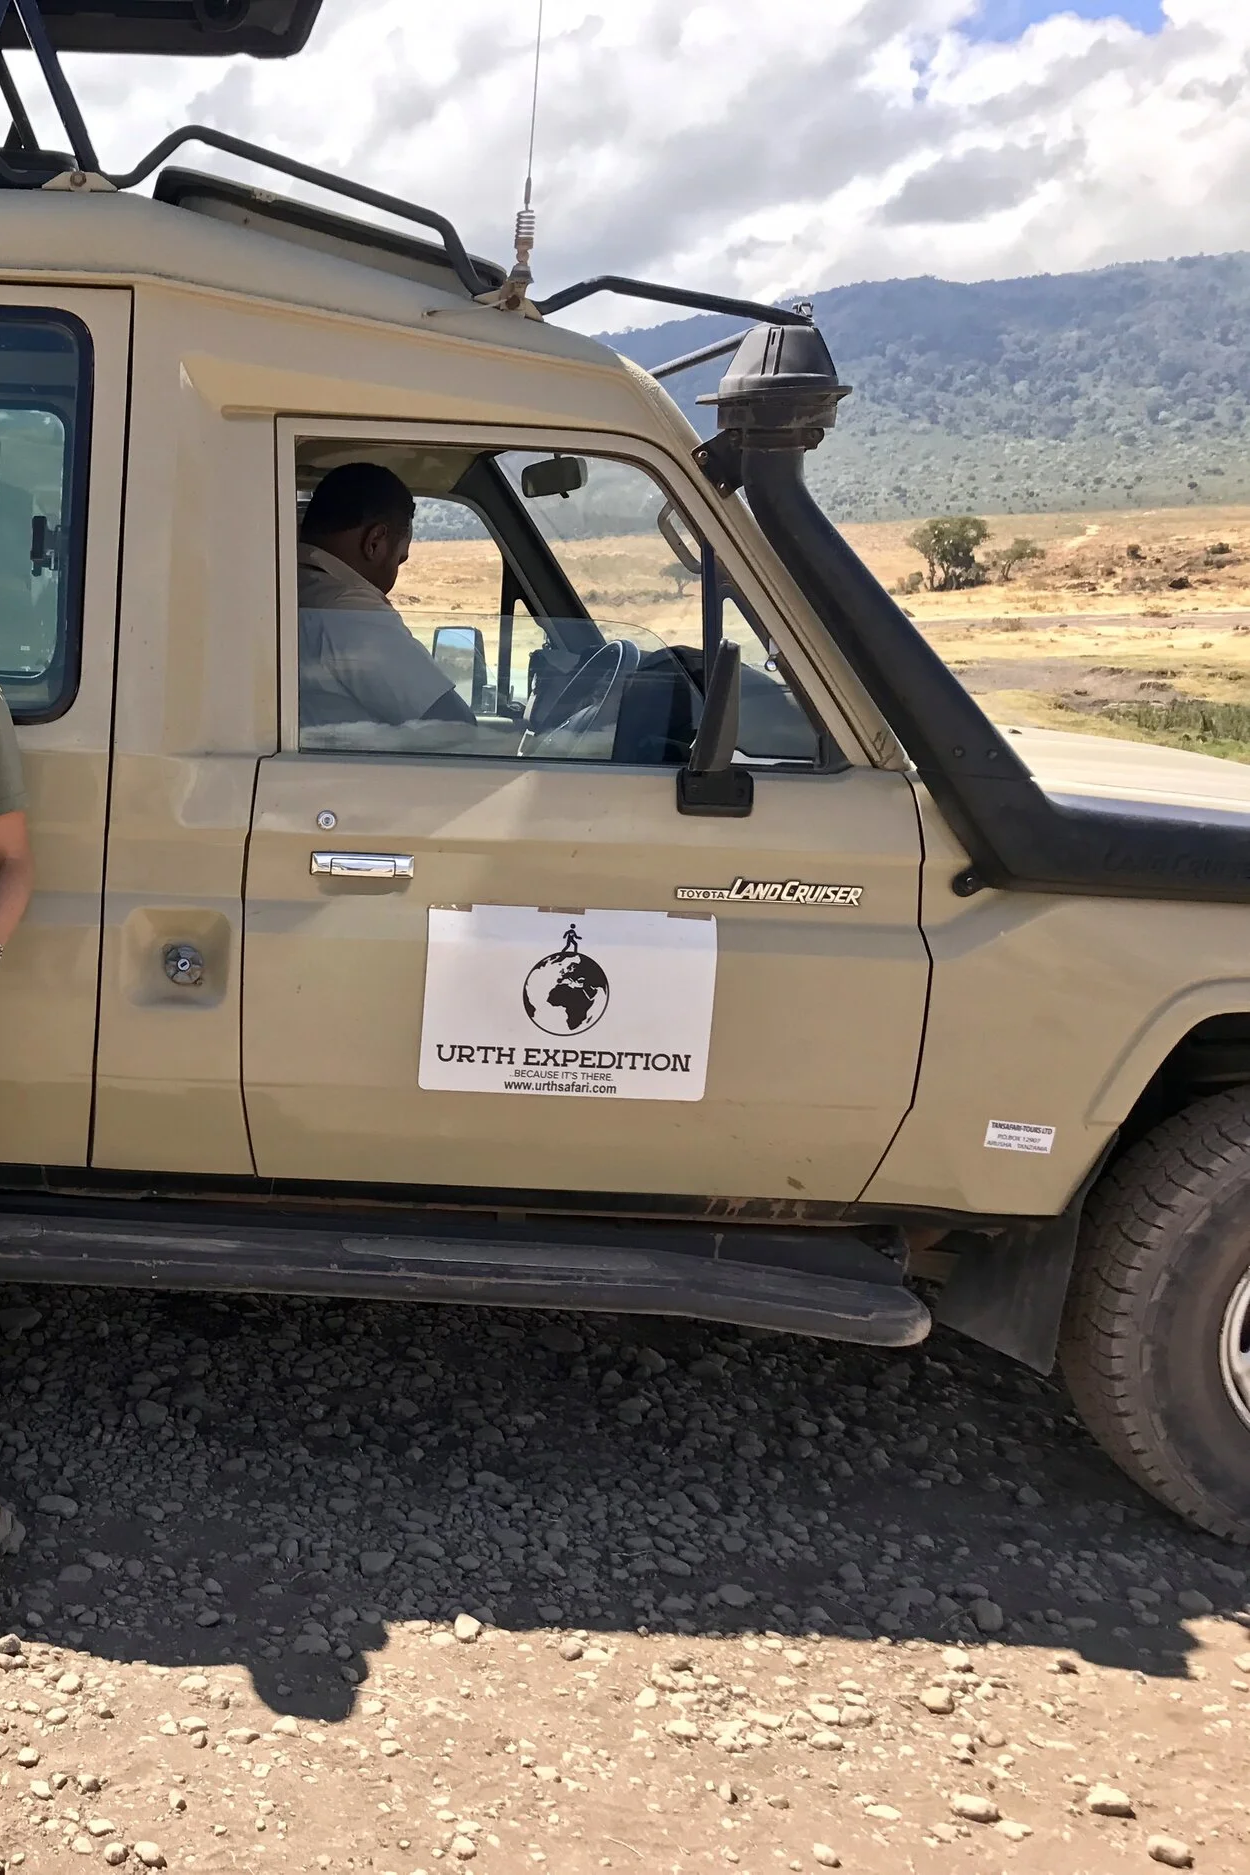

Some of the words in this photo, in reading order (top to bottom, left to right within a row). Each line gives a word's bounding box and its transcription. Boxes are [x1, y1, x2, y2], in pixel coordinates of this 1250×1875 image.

[679, 889, 725, 899] TOYOTA
[436, 1043, 516, 1065] URTH
[523, 1047, 691, 1072] EXPEDITION
[561, 1071, 578, 1080] IT'S
[504, 1081, 617, 1094] www.urthsafari.com
